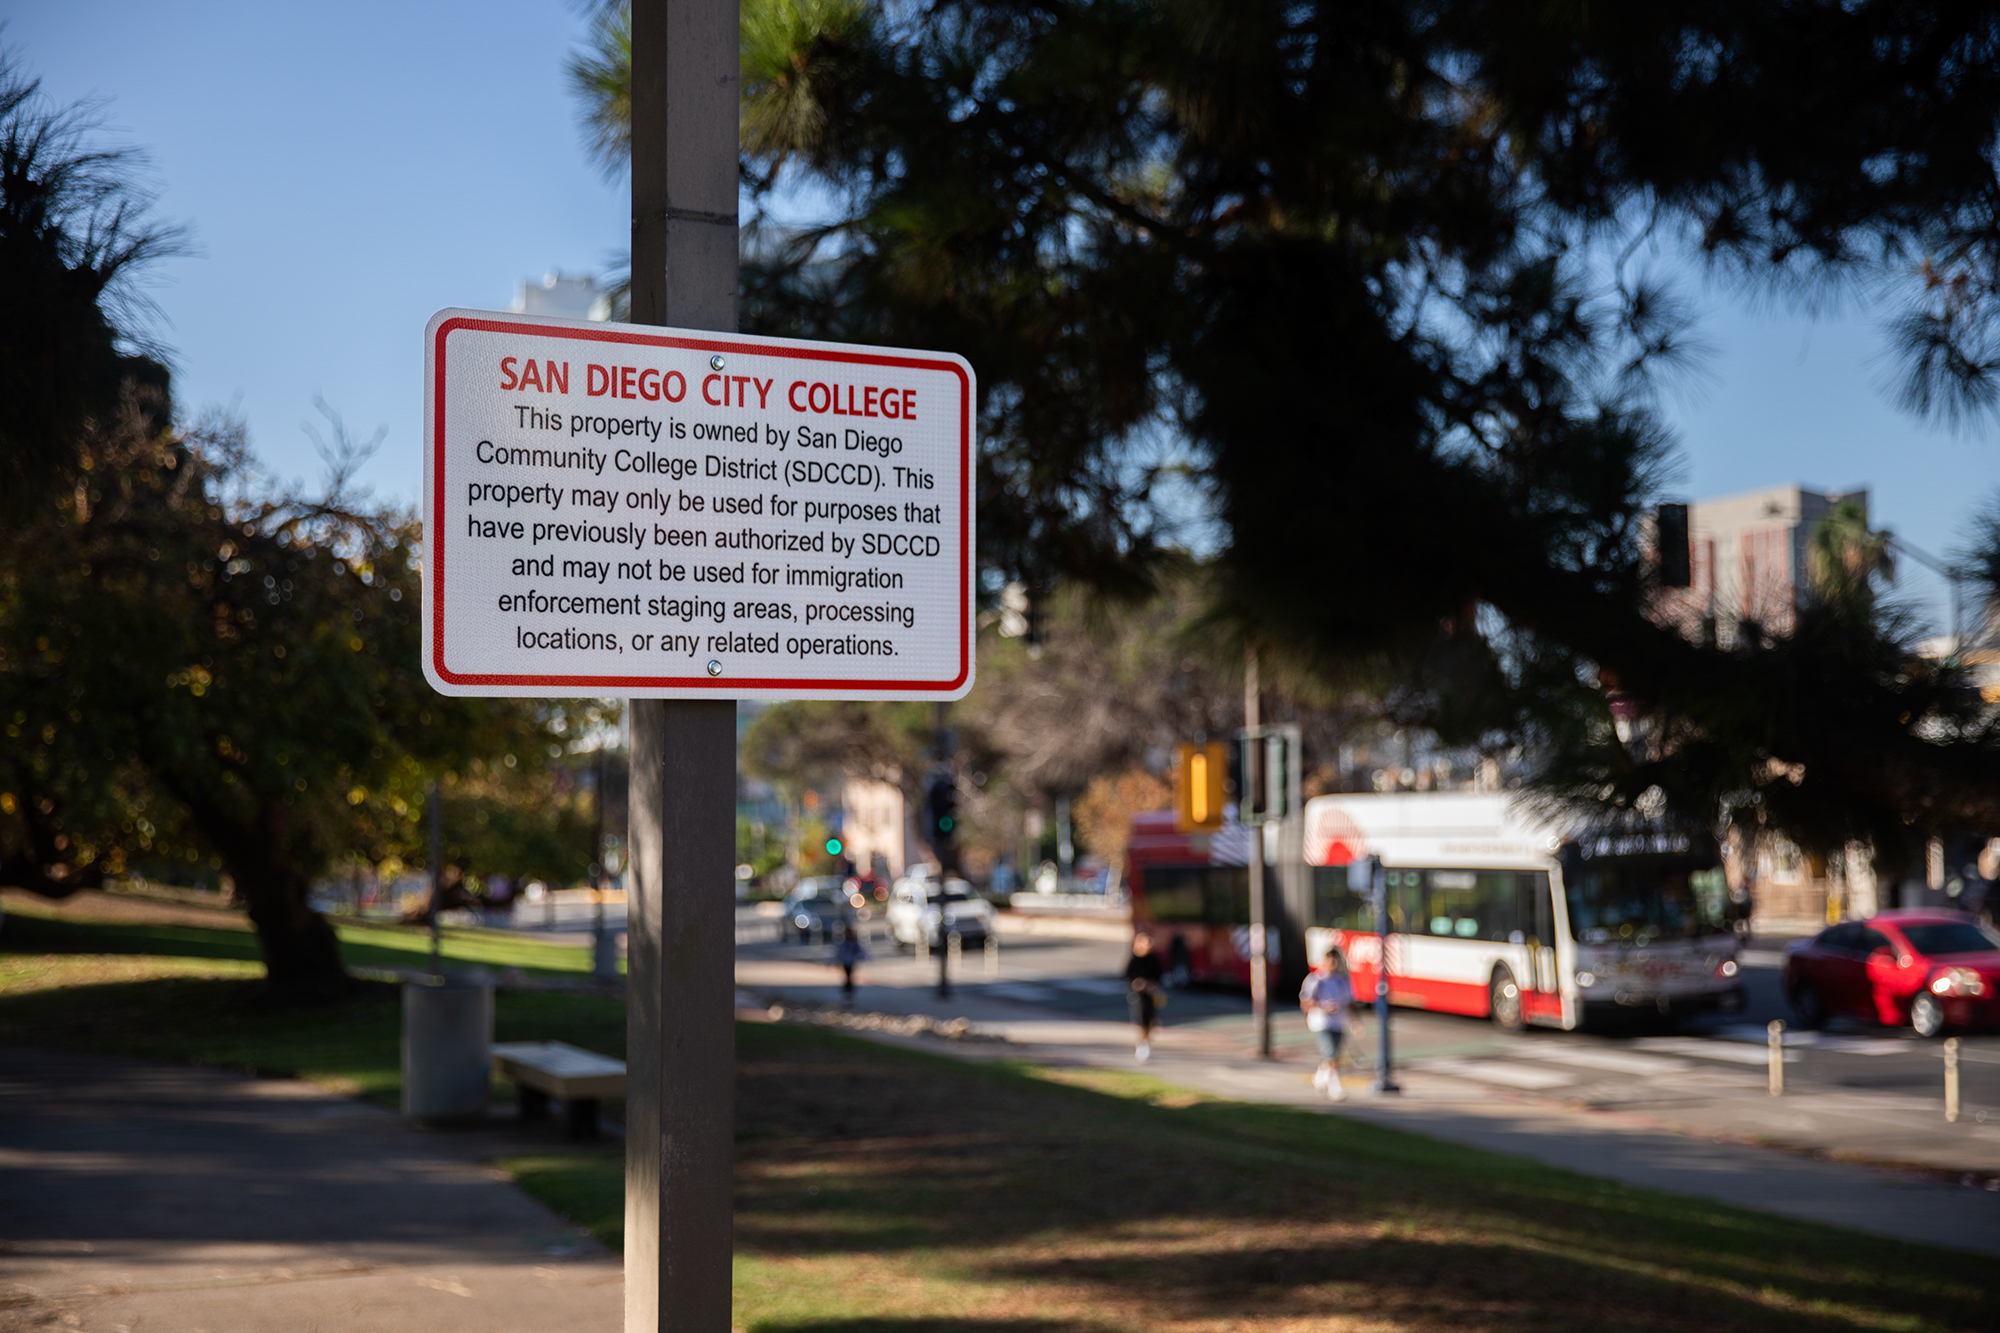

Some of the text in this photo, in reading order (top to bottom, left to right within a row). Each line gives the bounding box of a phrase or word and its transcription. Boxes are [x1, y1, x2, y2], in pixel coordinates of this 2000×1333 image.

[500, 356, 917, 421] SAN DIEGO CITY COLLEGE
[513, 405, 903, 459] This property is owned by San Diego
[476, 439, 935, 492] Community College District (SDCCD). This
[468, 482, 941, 525] property may only be used for purposes that
[468, 513, 941, 559] have previously been authorized by SDCCD
[511, 554, 903, 593] and may not be used for immigration
[498, 589, 915, 629] enforcement staging areas, processing
[517, 625, 899, 660] locations, or any related operations.
